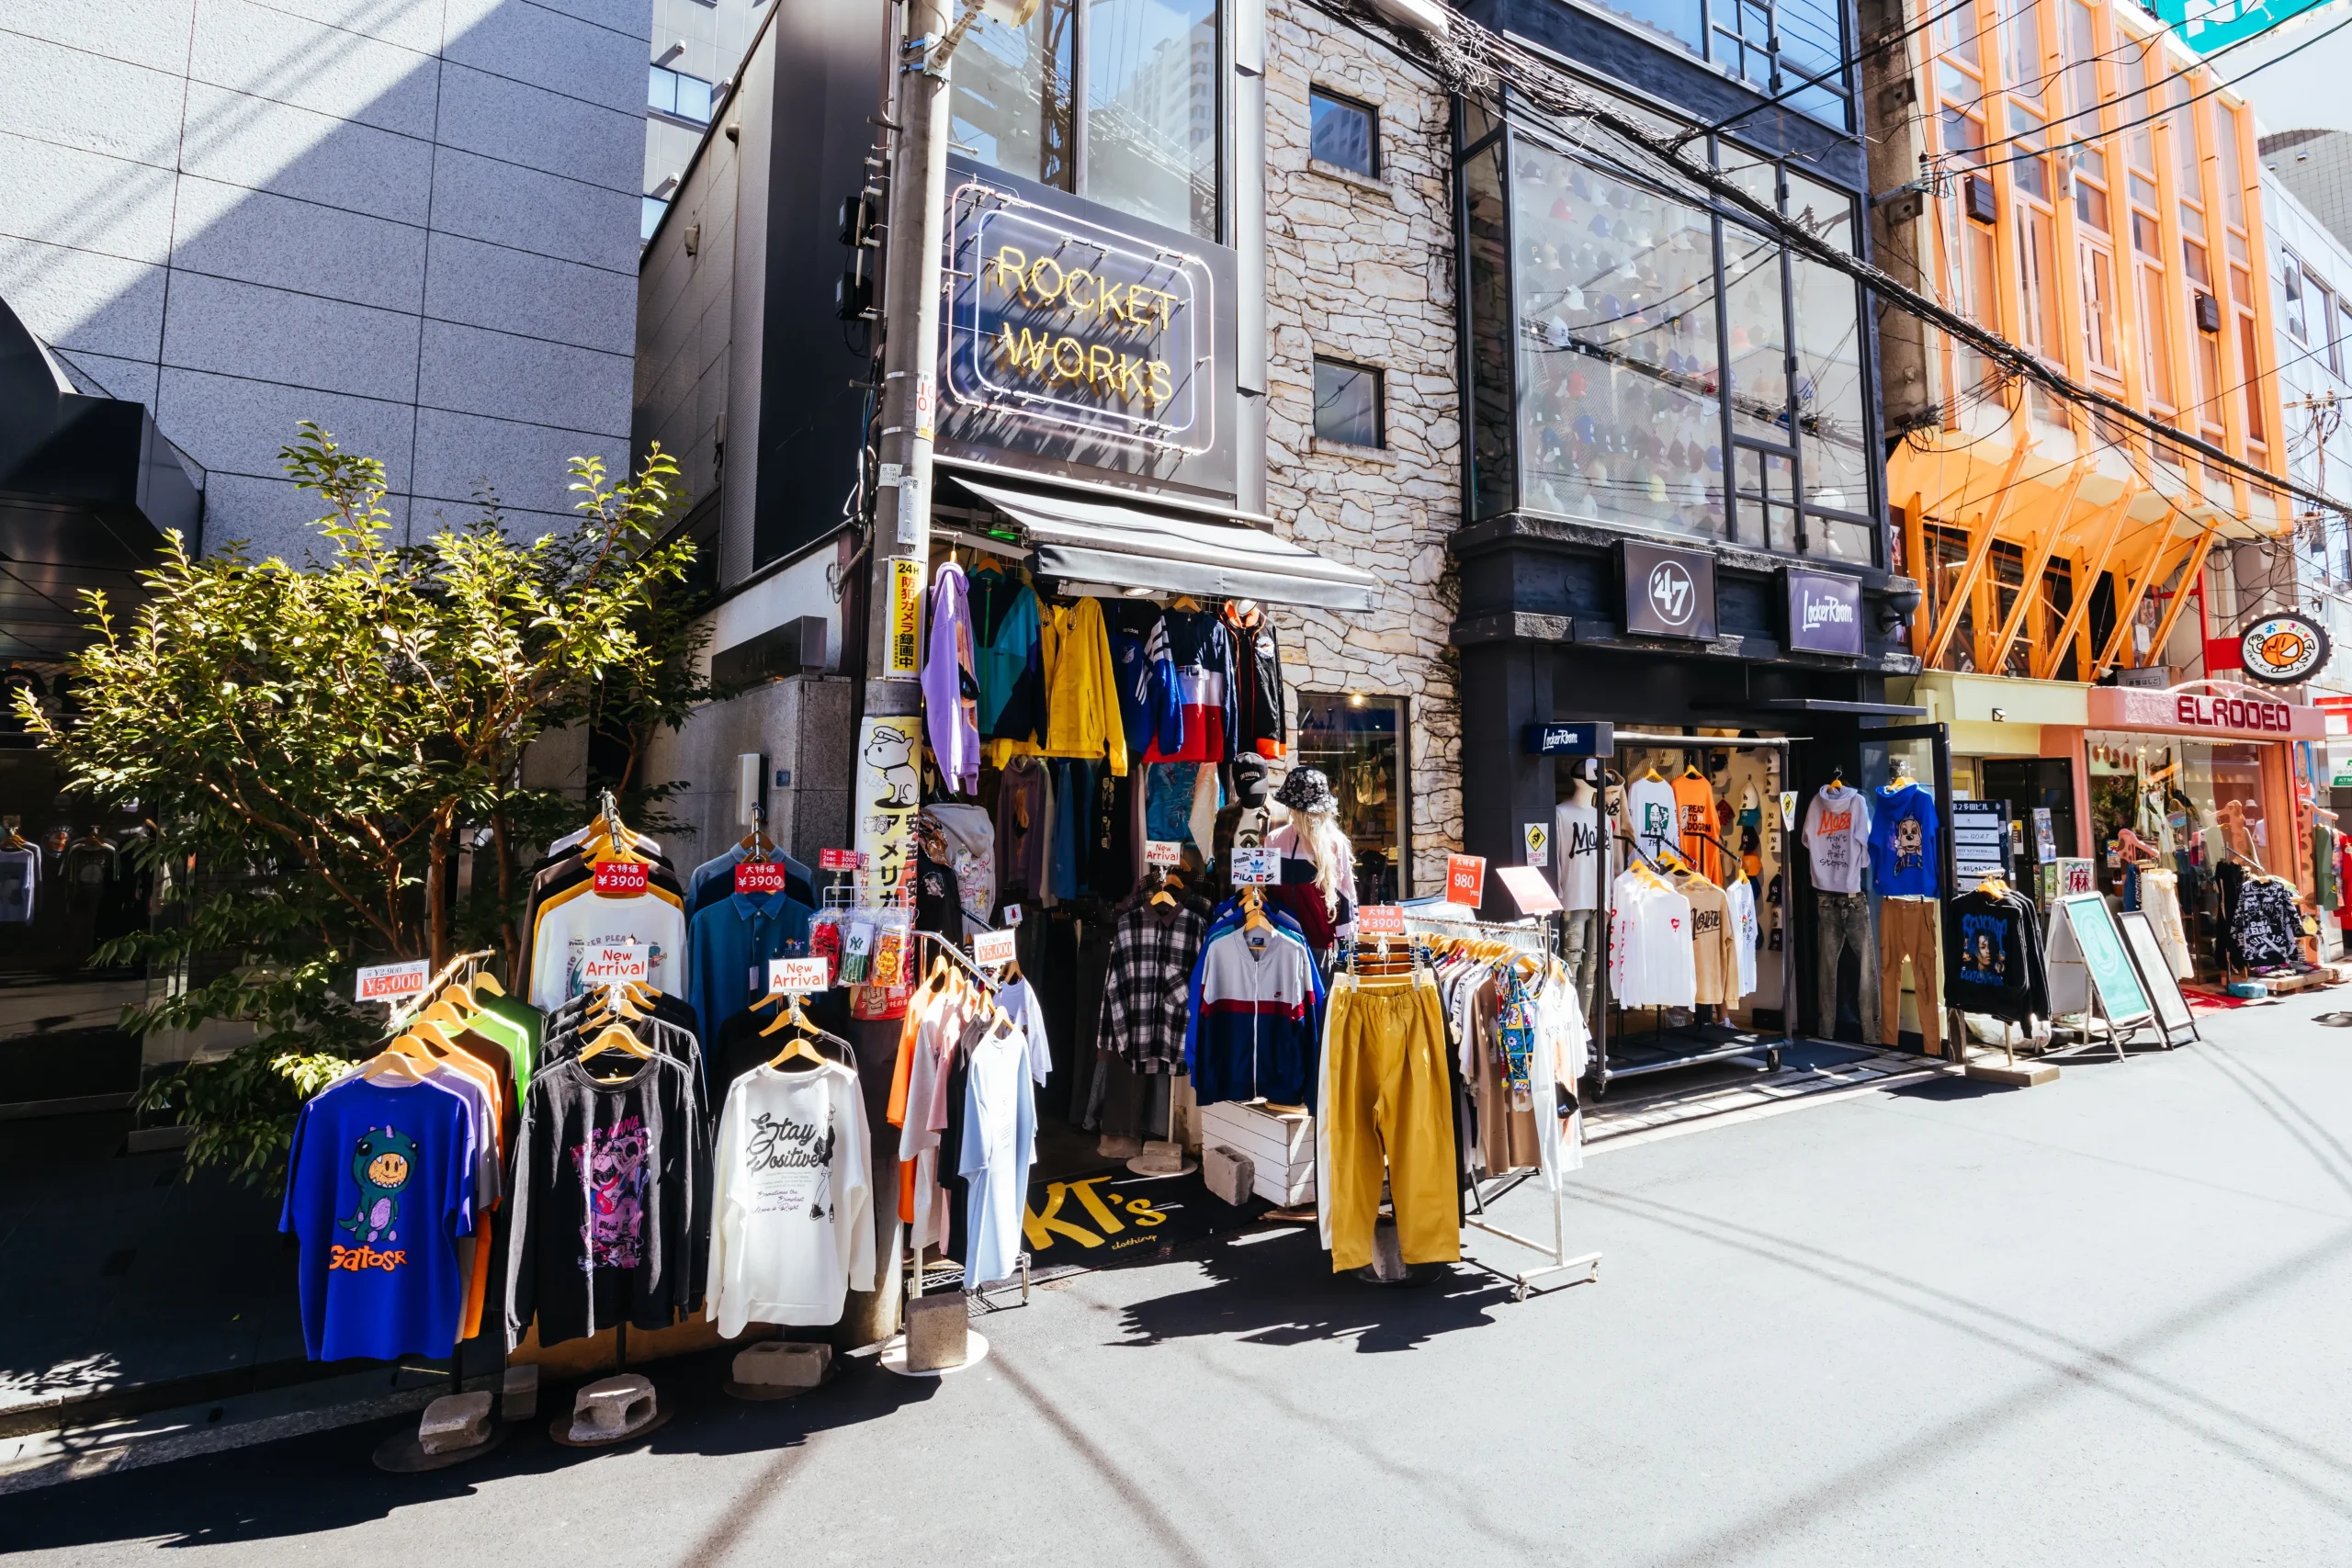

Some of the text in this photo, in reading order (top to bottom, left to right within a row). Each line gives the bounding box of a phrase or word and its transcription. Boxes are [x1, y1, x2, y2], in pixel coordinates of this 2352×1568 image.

[998, 246, 1178, 330] ROCKET
[1003, 322, 1172, 400] WORKS
[899, 563, 919, 575] 24H
[899, 576, 915, 668] 防犯カメラ録画中
[2265, 622, 2305, 634] おおきに
[2177, 695, 2291, 732] ELRODEO
[1155, 843, 1171, 852] New
[1147, 851, 1179, 862] Arrival
[606, 863, 639, 874] 大特価
[745, 864, 775, 874] 大特価
[1233, 872, 1253, 882] FILA
[1454, 873, 1475, 888] 980
[2068, 868, 2090, 892] 麻
[1368, 908, 1395, 916] 大特価
[603, 949, 632, 962] New
[979, 942, 1012, 960] ¥5,000
[374, 966, 402, 976] ¥2,900
[586, 961, 645, 976] Arrival
[786, 963, 813, 973] New
[366, 974, 422, 993] ¥5,000
[773, 973, 824, 987] Arrival
[607, 1115, 640, 1138] NANA
[746, 1112, 816, 1156] Stay
[1023, 1176, 1167, 1251] KT's
[1111, 1234, 1158, 1250] clothing
